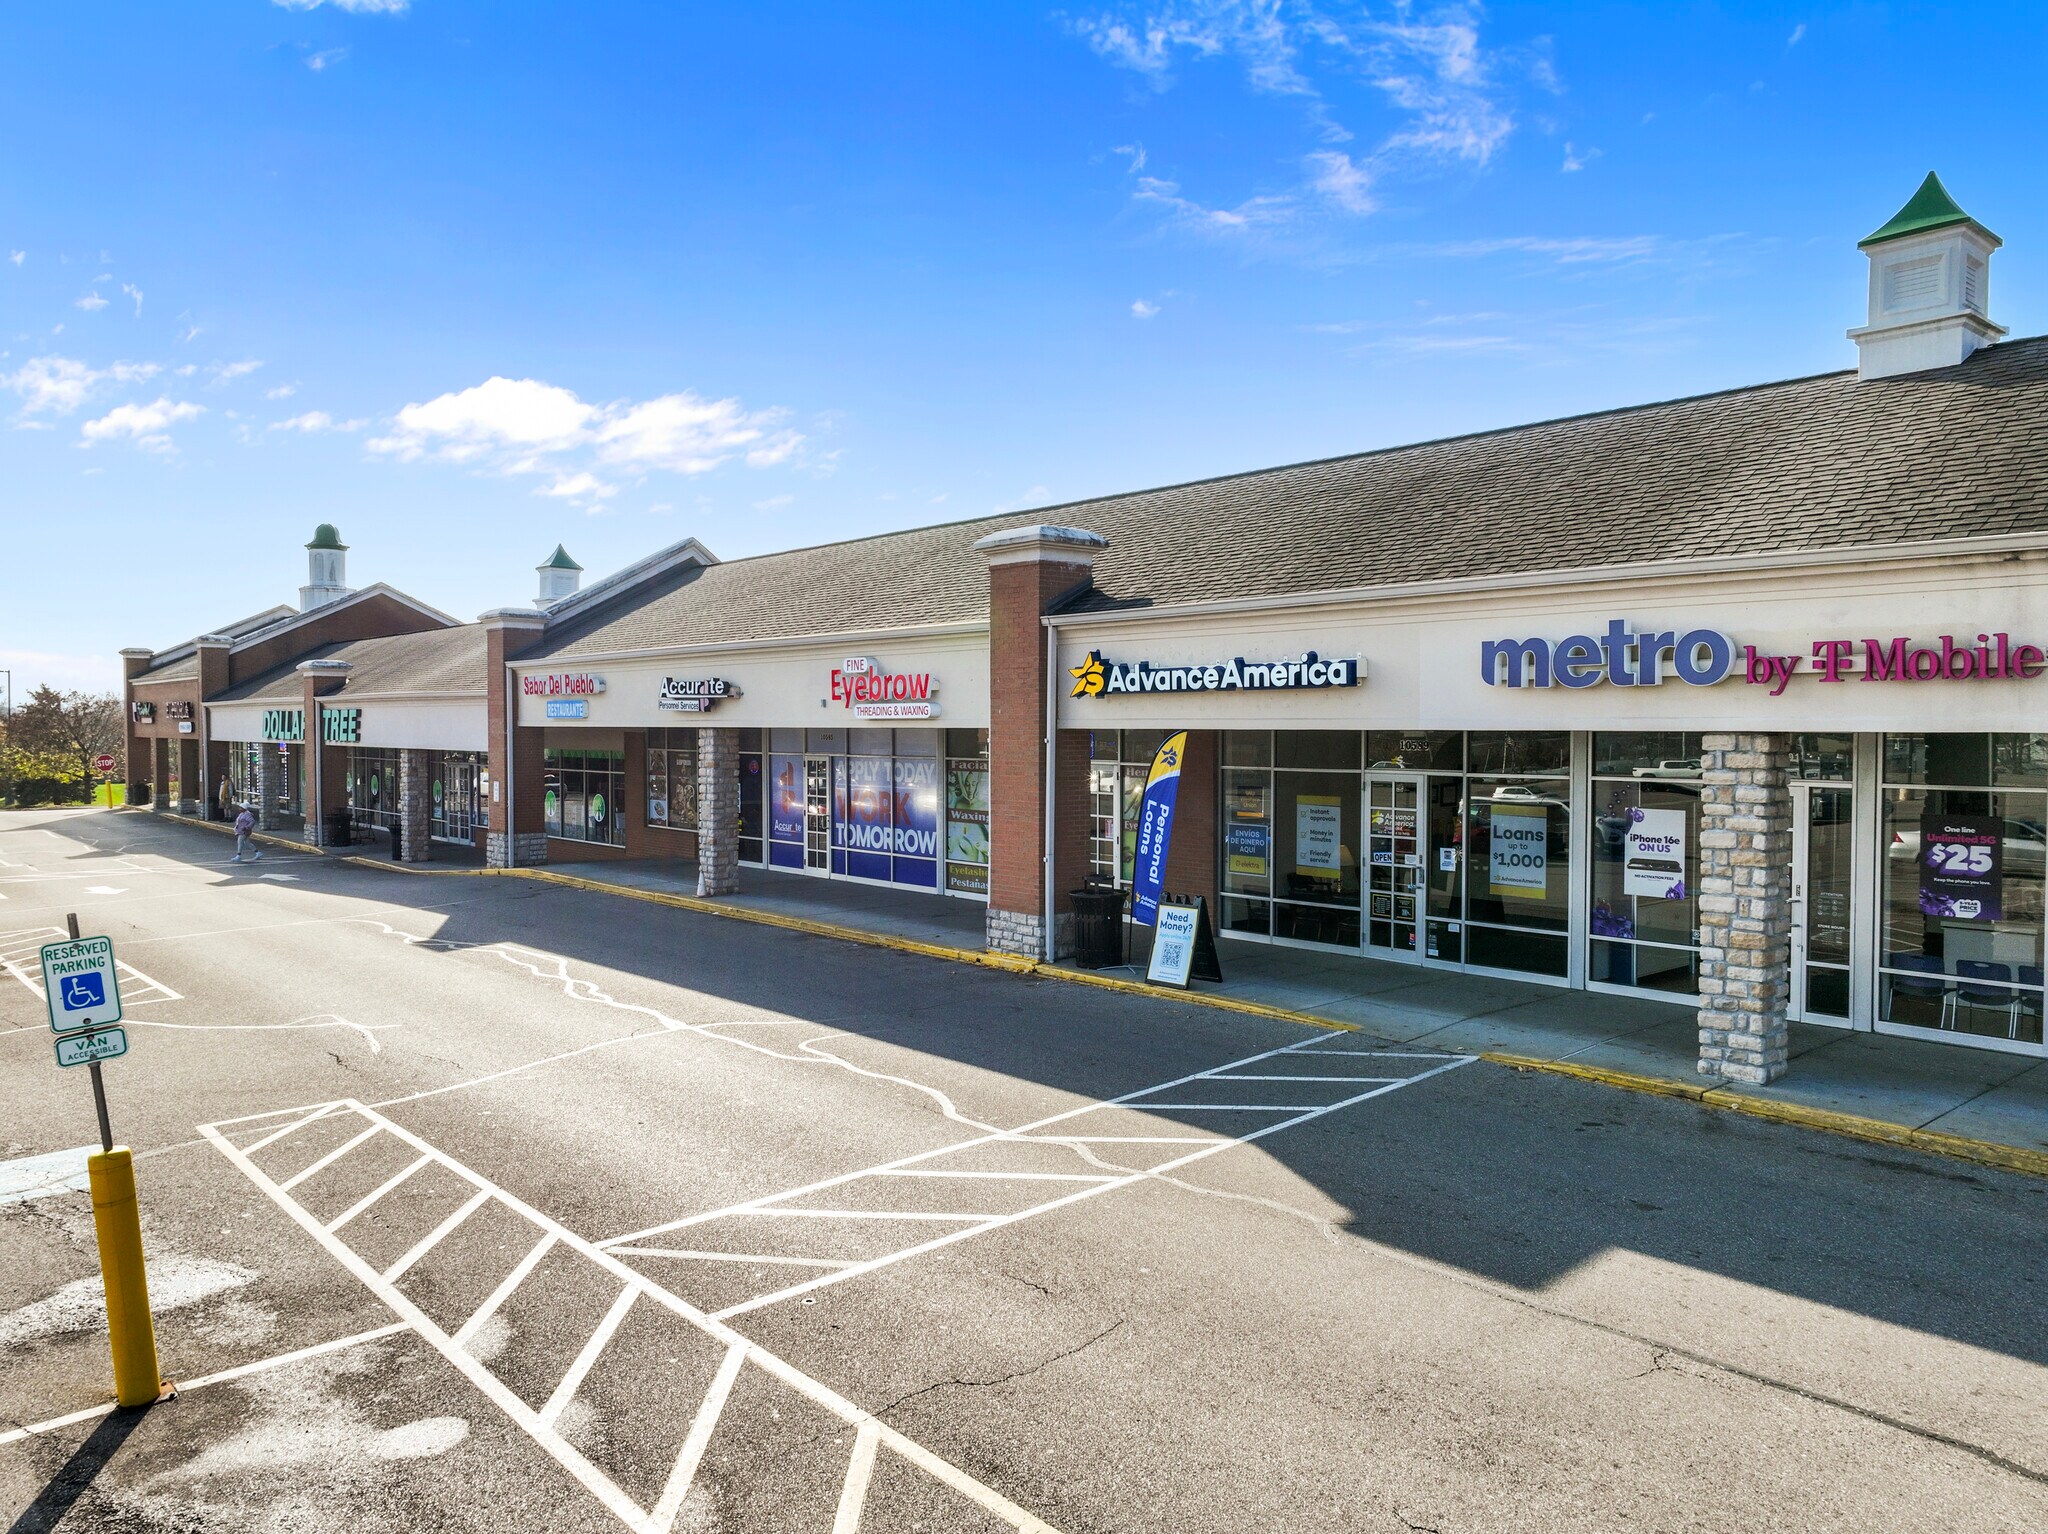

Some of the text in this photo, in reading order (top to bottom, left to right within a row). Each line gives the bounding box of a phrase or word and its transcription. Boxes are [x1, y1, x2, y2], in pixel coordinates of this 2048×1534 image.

[1481, 619, 1733, 689] metro
[1743, 645, 1802, 696] by
[846, 659, 865, 671] FINE
[524, 673, 594, 696] Sabor Del Pueblo
[660, 677, 725, 698] Accurate
[831, 665, 930, 709] Eyebrow
[547, 703, 584, 717] RESTAURANTE
[659, 701, 699, 710] Personnel Services
[856, 705, 929, 716] THREADING & WAXING
[322, 709, 358, 742] TREE
[1400, 739, 1430, 752] 10589
[97, 759, 114, 767] STOP
[951, 760, 989, 771] Facia
[836, 760, 936, 784] APPLY TODAY
[836, 789, 912, 826] WORK
[1384, 812, 1415, 821] Advance
[1140, 799, 1158, 856] Loans
[1235, 829, 1260, 838] ENVÍOS
[1309, 829, 1327, 837] Money
[1493, 824, 1544, 841] Loans
[1961, 826, 1976, 834] line
[836, 822, 937, 855] TOMORROW
[1149, 803, 1170, 885] Personal
[1230, 837, 1265, 847] DE DINERO
[1309, 835, 1332, 843] minutes
[1629, 833, 1681, 845] iPhone 16e
[1927, 833, 1997, 845] Unlimited 5G
[1239, 845, 1256, 854] AQUÍ
[1519, 842, 1528, 850] to
[1638, 843, 1671, 853] ON US
[1309, 849, 1331, 858] Friendly
[1374, 853, 1392, 861] OPEN
[1493, 851, 1544, 868] $1,000
[1931, 842, 1993, 873] $25
[1139, 899, 1156, 910] America
[1140, 894, 1157, 905] Advance
[1167, 911, 1189, 922] Need
[1160, 920, 1193, 934] Money?
[45, 941, 108, 962] RESERVED
[52, 956, 106, 975] PARKING
[75, 1036, 108, 1051] VAN
[67, 1044, 118, 1061] ACCESSIBLE
